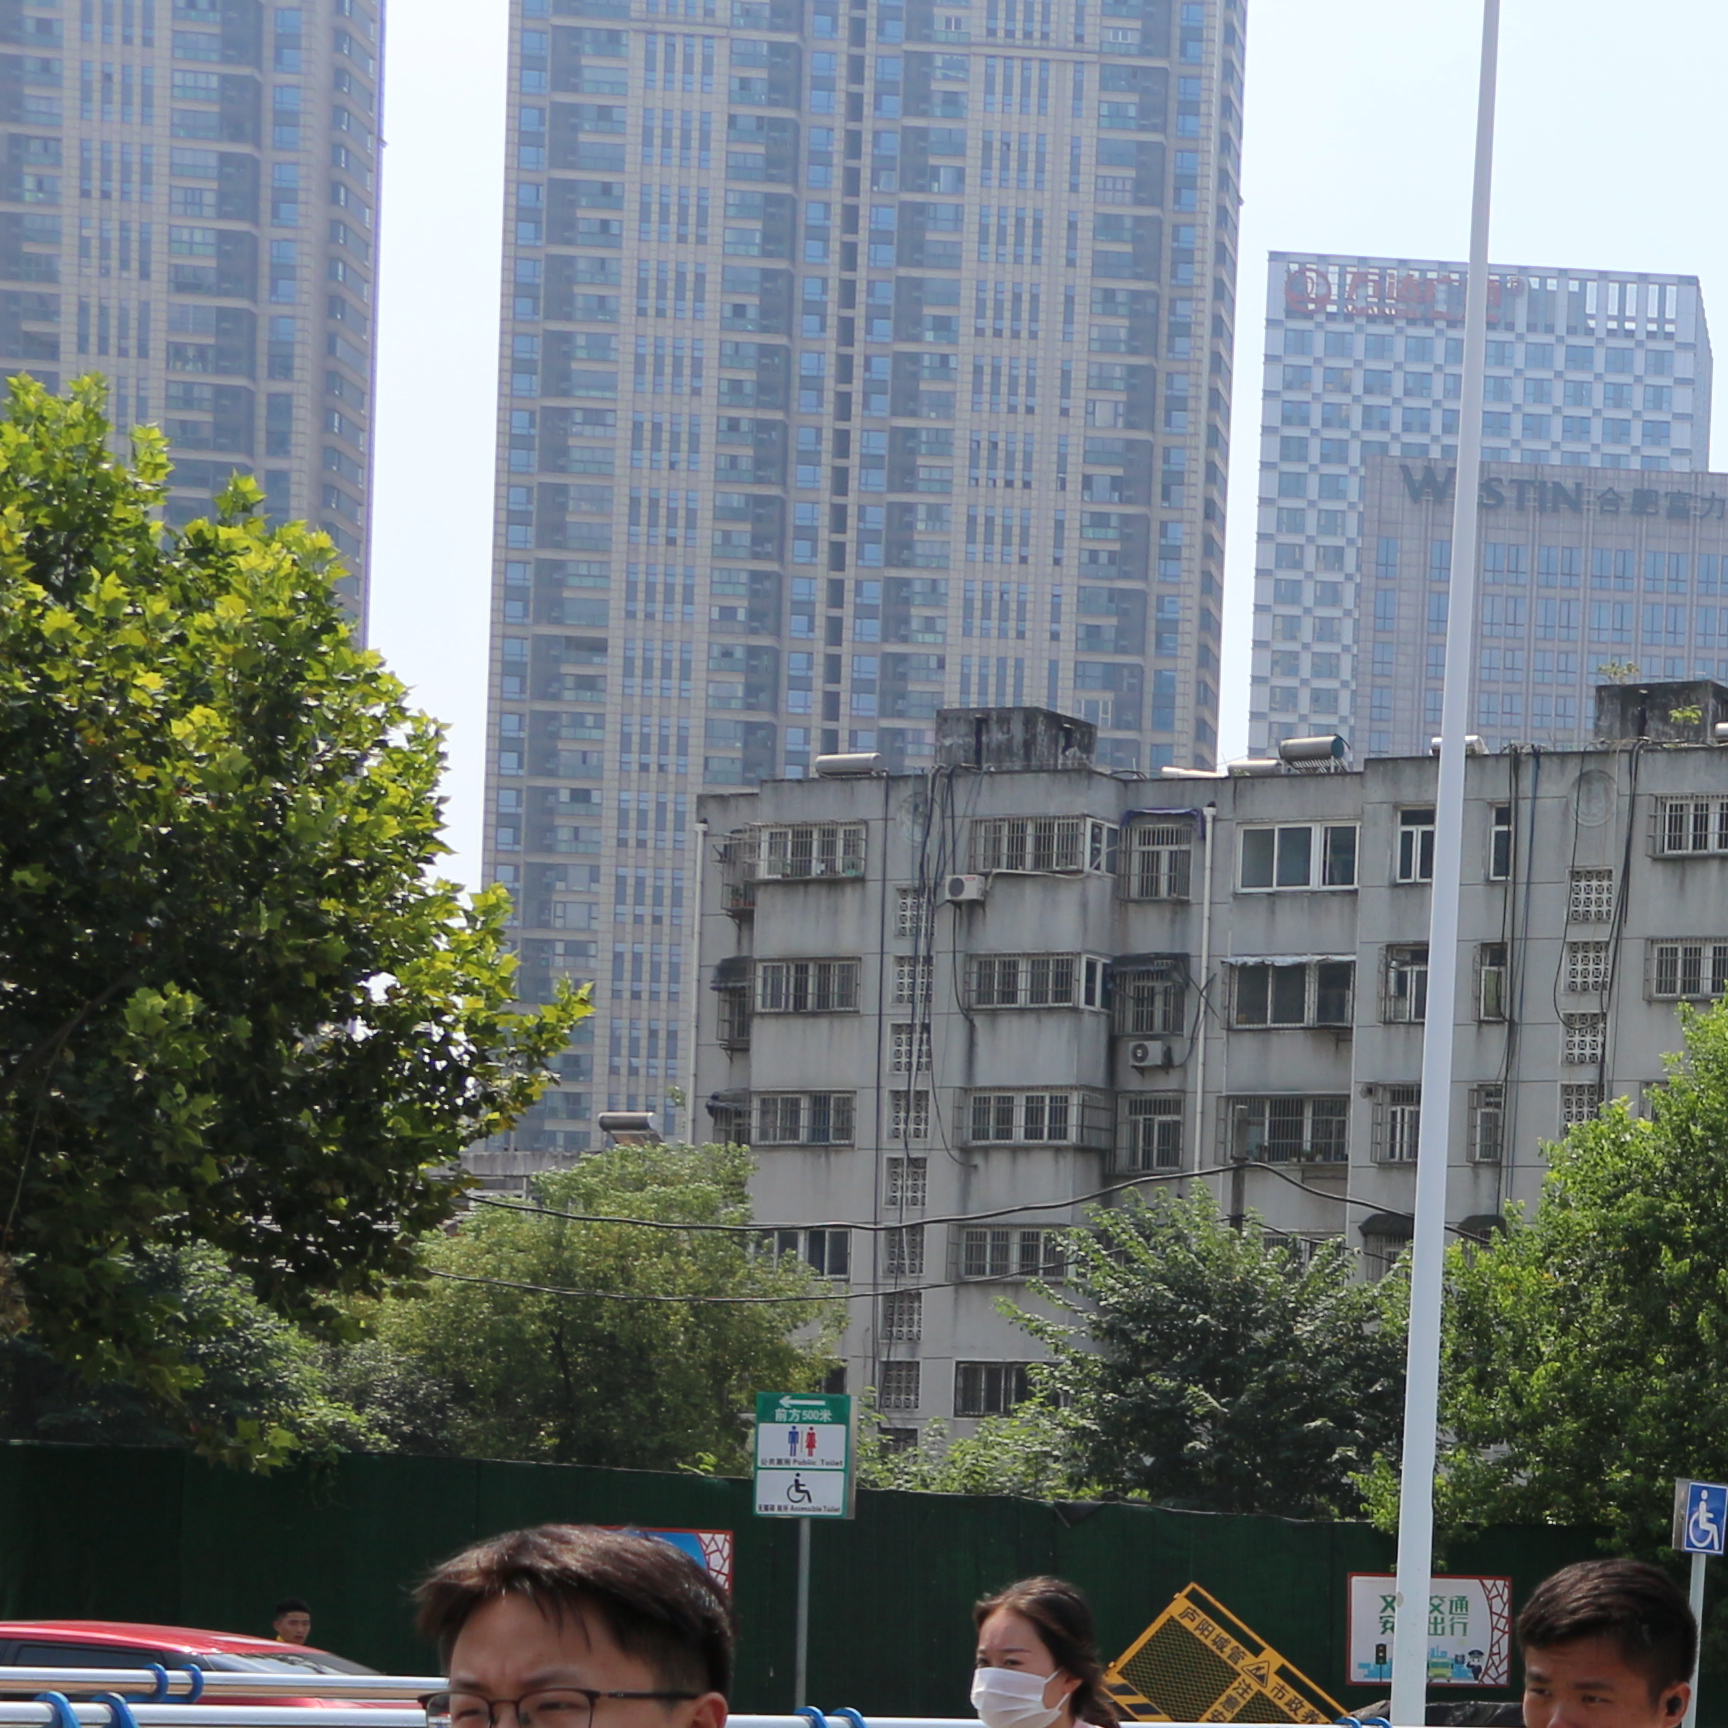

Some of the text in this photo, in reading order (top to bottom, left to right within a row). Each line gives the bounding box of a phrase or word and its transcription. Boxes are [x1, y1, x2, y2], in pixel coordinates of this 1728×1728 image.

[1400, 464, 1582, 514] WSTIN
[775, 1408, 832, 1422] 前方500米
[1379, 1594, 1469, 1615] 文交通
[1178, 1606, 1249, 1665] 庐阳城管
[1378, 1614, 1469, 1637] 安出行
